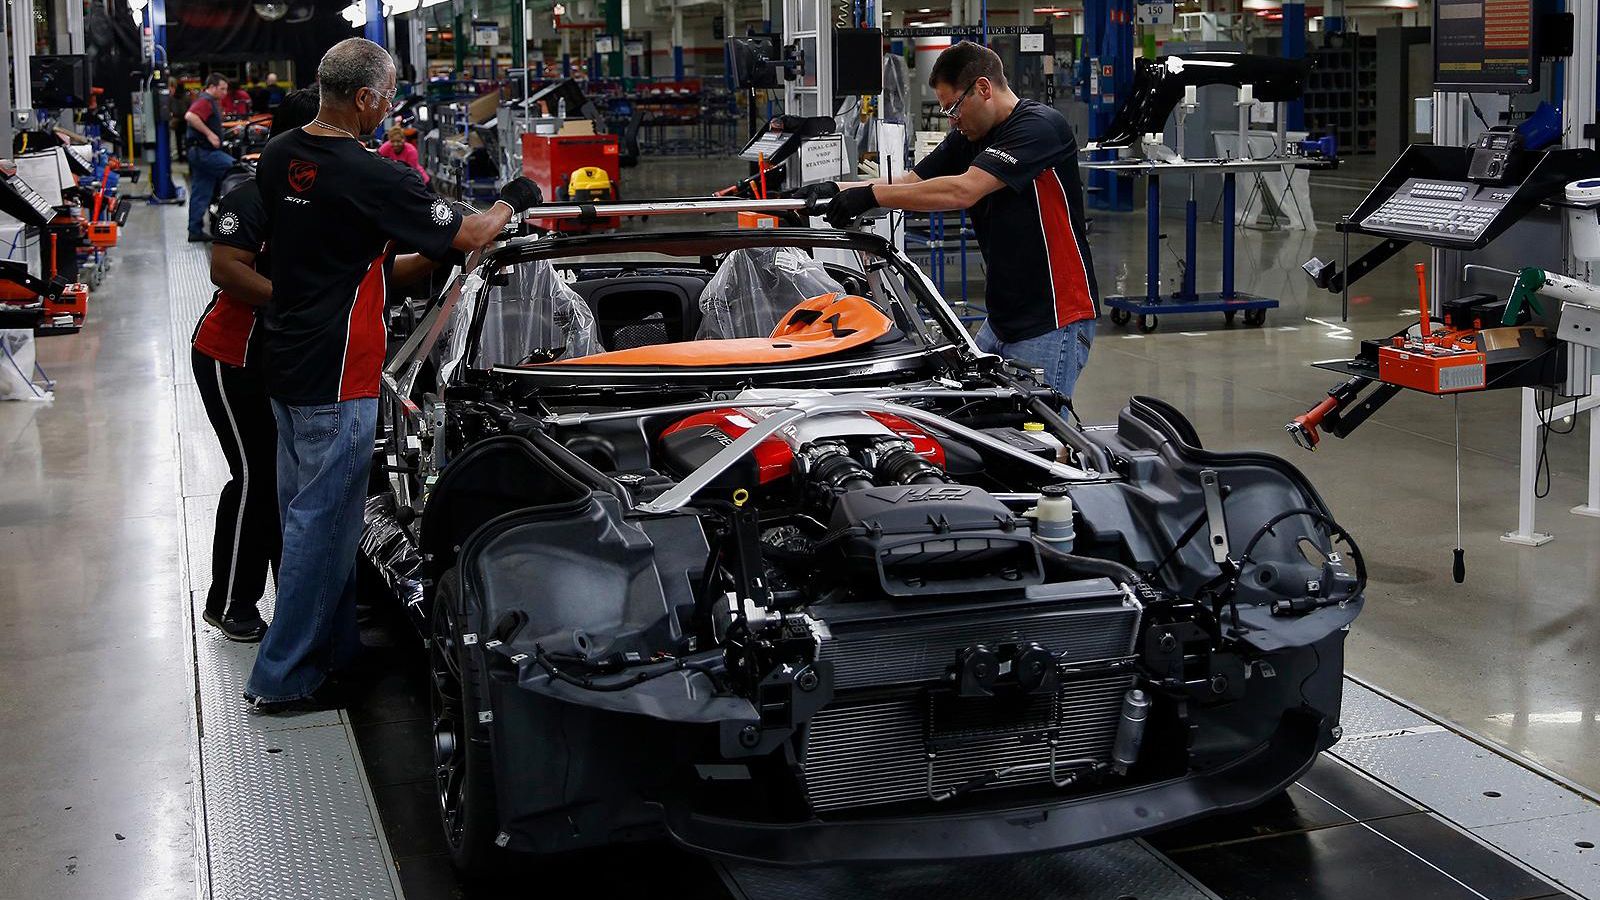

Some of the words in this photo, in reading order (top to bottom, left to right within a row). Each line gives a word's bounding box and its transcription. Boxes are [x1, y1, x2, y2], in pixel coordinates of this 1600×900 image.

[1148, 6, 1163, 15] 150
[1010, 25, 1031, 34] SIDE
[806, 159, 830, 168] STATION
[284, 196, 311, 205] SRT
[700, 428, 735, 448] VIPE
